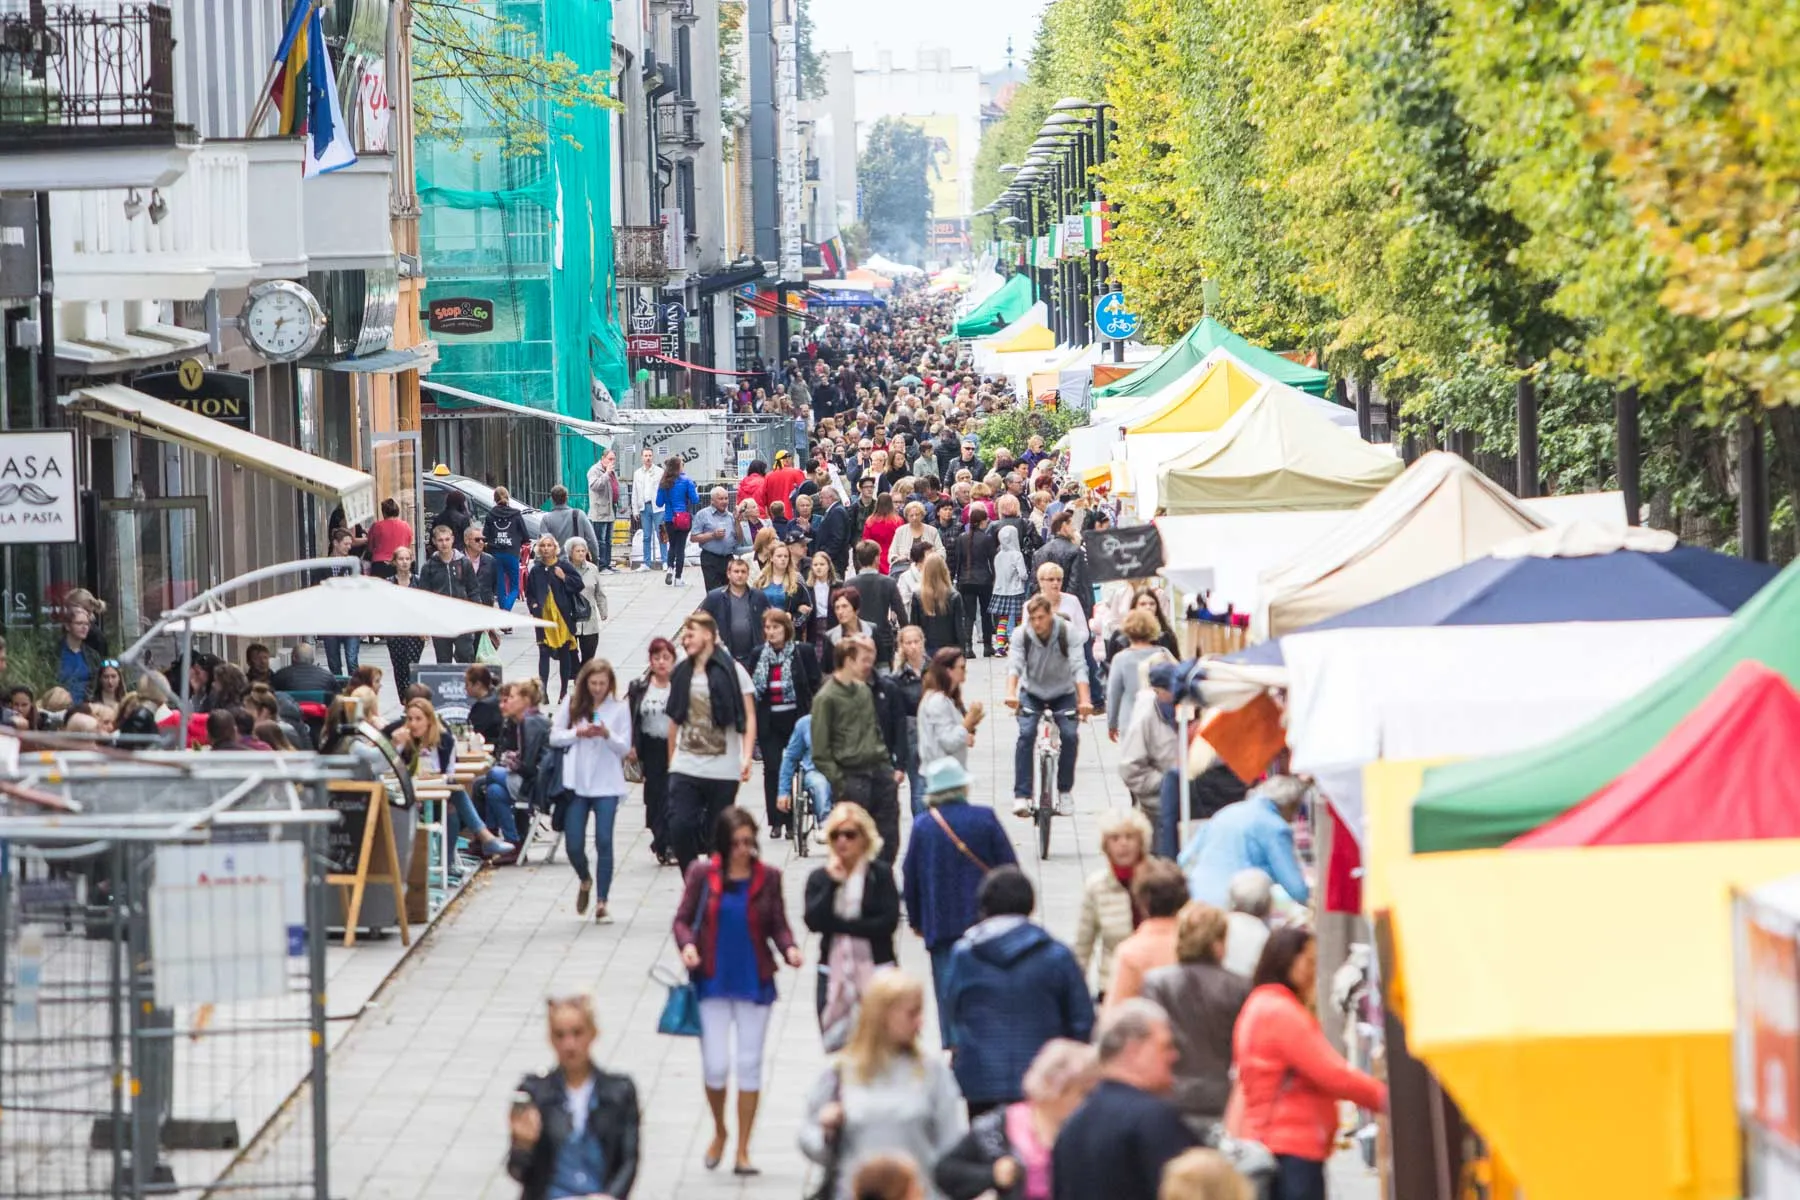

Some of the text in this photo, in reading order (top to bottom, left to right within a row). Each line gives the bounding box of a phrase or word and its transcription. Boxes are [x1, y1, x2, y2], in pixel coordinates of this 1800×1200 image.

[435, 302, 488, 320] Stop&Go
[633, 318, 655, 328] VERO
[184, 367, 199, 387] V
[23, 512, 63, 524] PASTA
